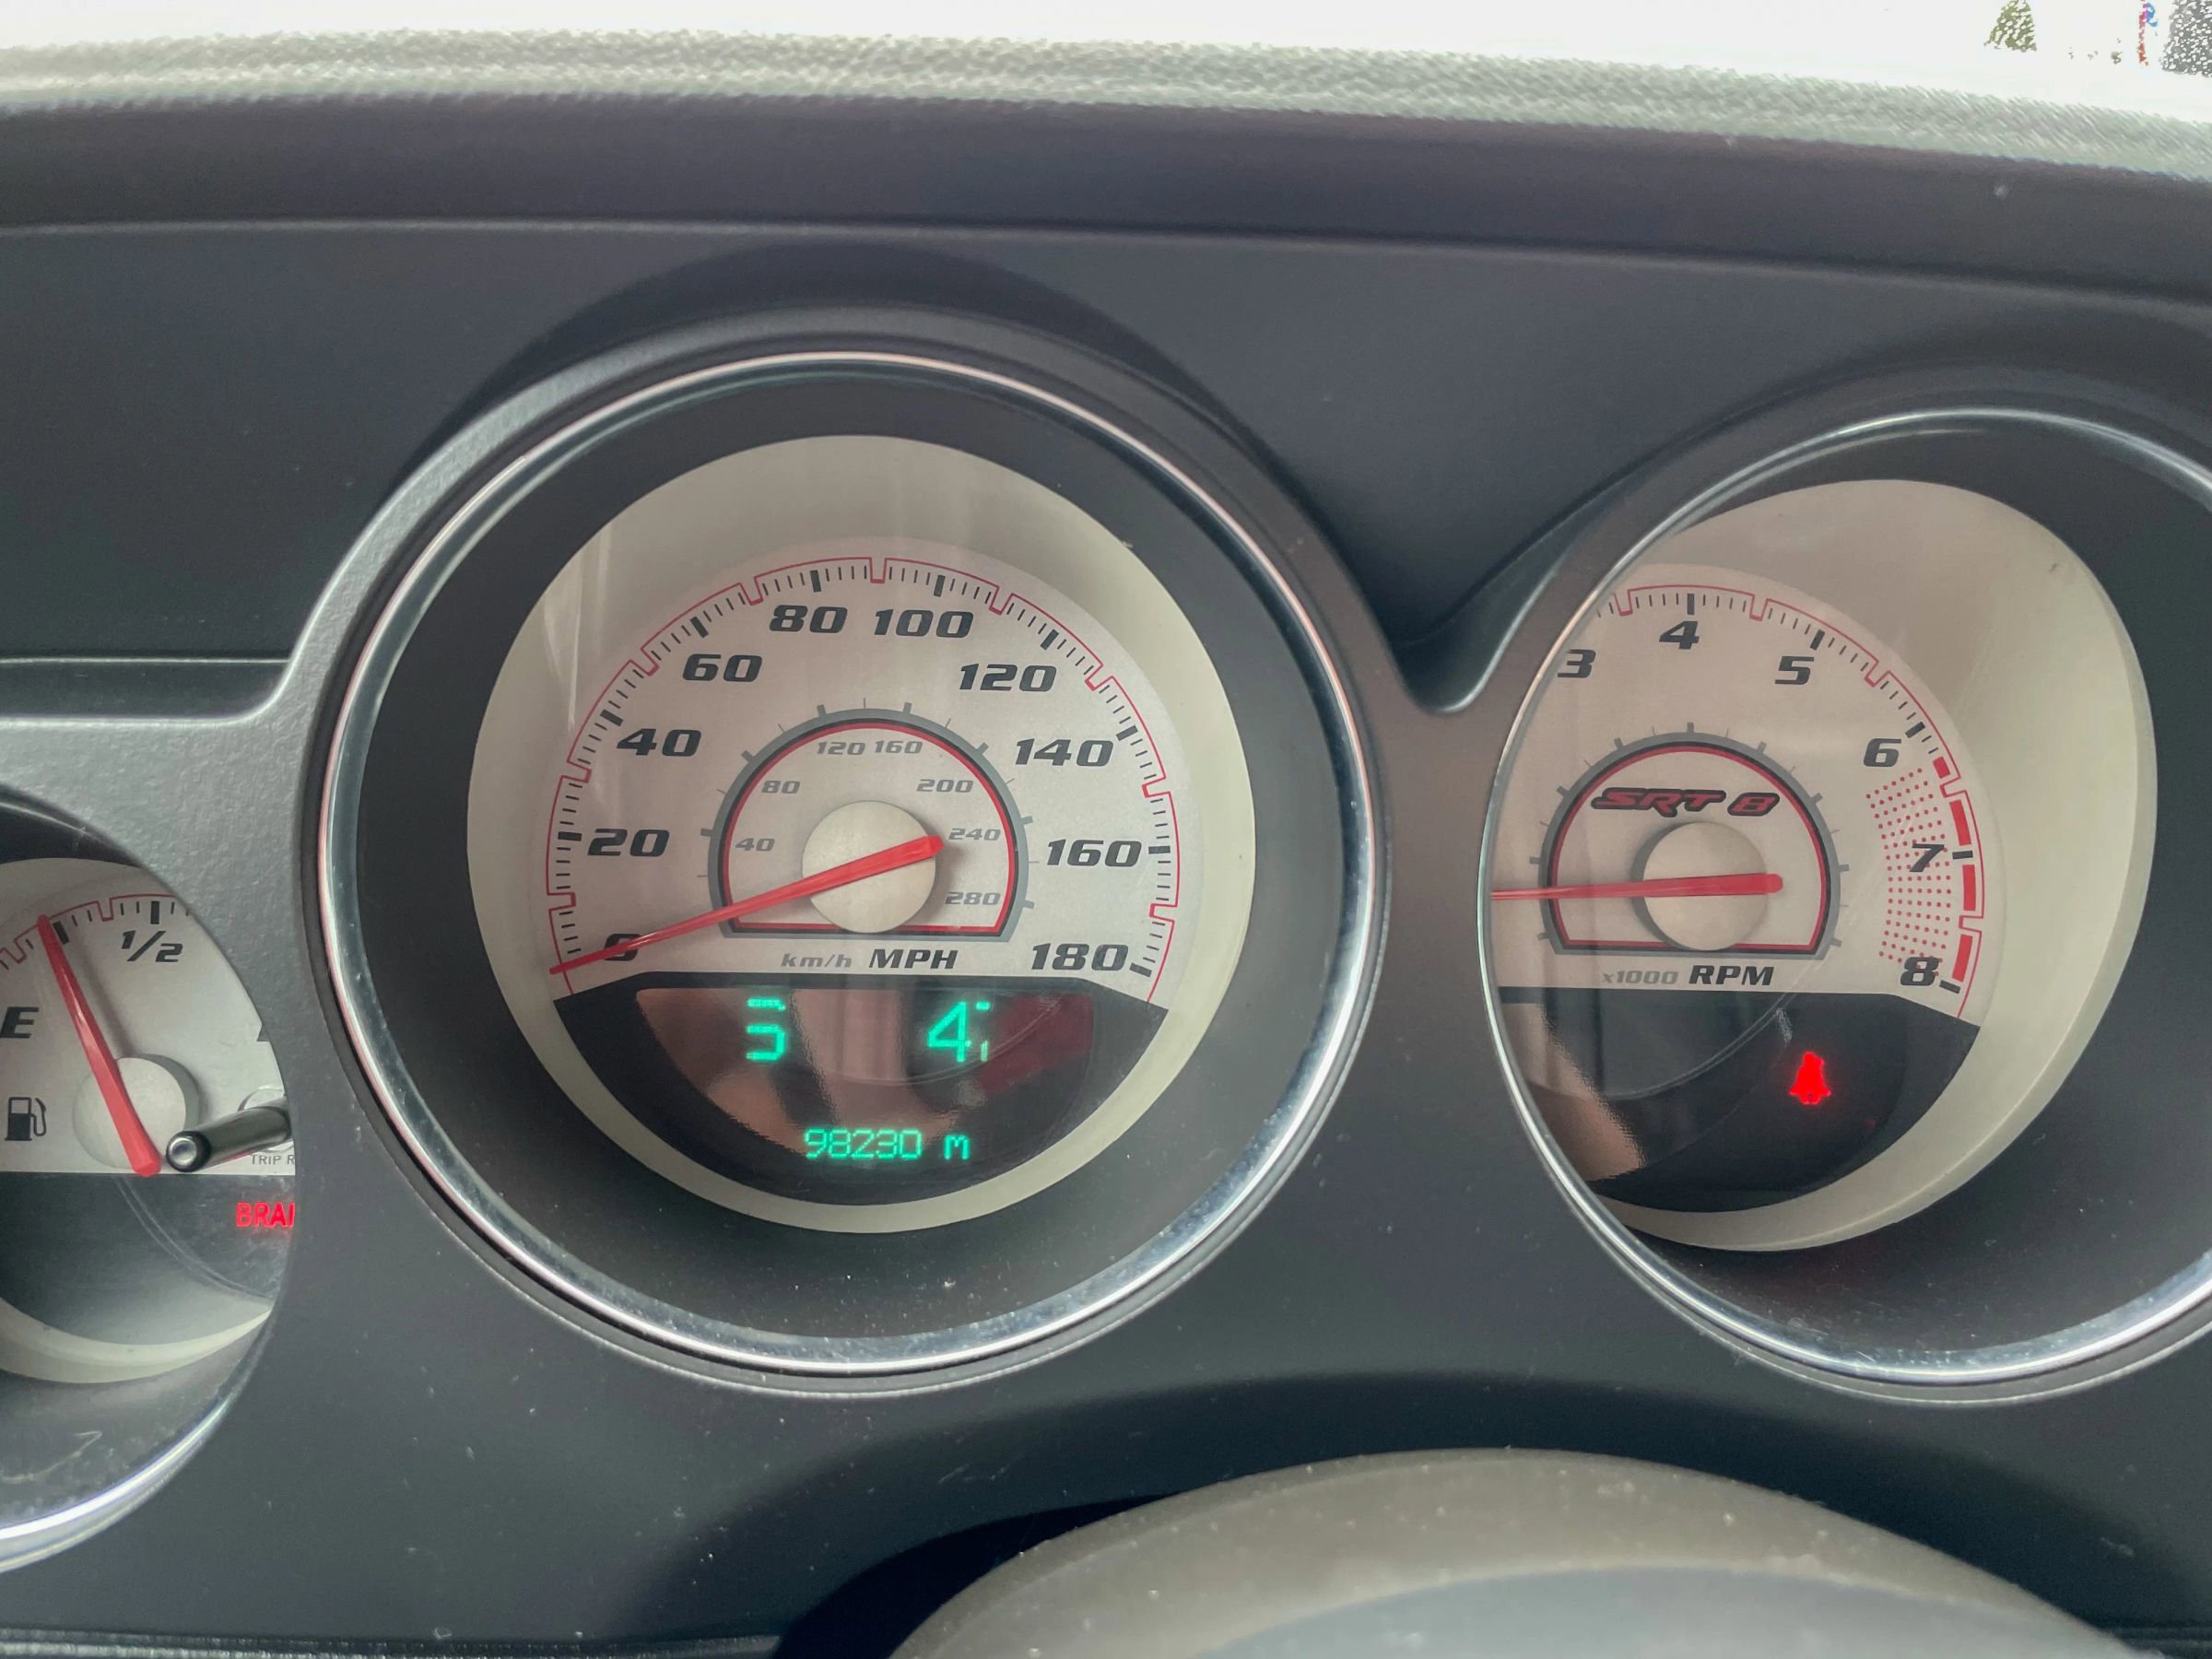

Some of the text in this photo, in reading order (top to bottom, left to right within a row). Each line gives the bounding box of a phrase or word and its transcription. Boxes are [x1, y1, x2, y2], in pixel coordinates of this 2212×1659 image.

[769, 604, 848, 634] 80
[874, 608, 974, 639] 100
[1658, 620, 1700, 650] 4
[682, 653, 763, 683] 60
[959, 663, 1057, 692] 120
[1557, 649, 1596, 678] 3
[1774, 655, 1815, 686] 5
[616, 728, 702, 757] 40
[817, 741, 865, 756] 120
[875, 740, 924, 754] 160
[1015, 738, 1114, 767] 140
[1863, 737, 1902, 768] 6
[761, 781, 801, 794] 80
[916, 779, 974, 794] 200
[1591, 787, 1781, 818] SRT 8
[587, 828, 670, 857] 20
[735, 837, 775, 852] 40
[948, 828, 1002, 841] 240
[1046, 839, 1142, 867] 160
[1909, 842, 1946, 873] 7
[945, 891, 1002, 906] 280
[121, 929, 183, 963] 1/2
[603, 933, 641, 962] 0
[1031, 943, 1129, 973] 180
[781, 949, 959, 974] km/h MPH
[1602, 965, 1774, 986] x1000 RPM
[1900, 956, 1939, 987] 8
[0, 1006, 40, 1039] E
[804, 1127, 923, 1160] 98230
[251, 1154, 282, 1165] TRIP
